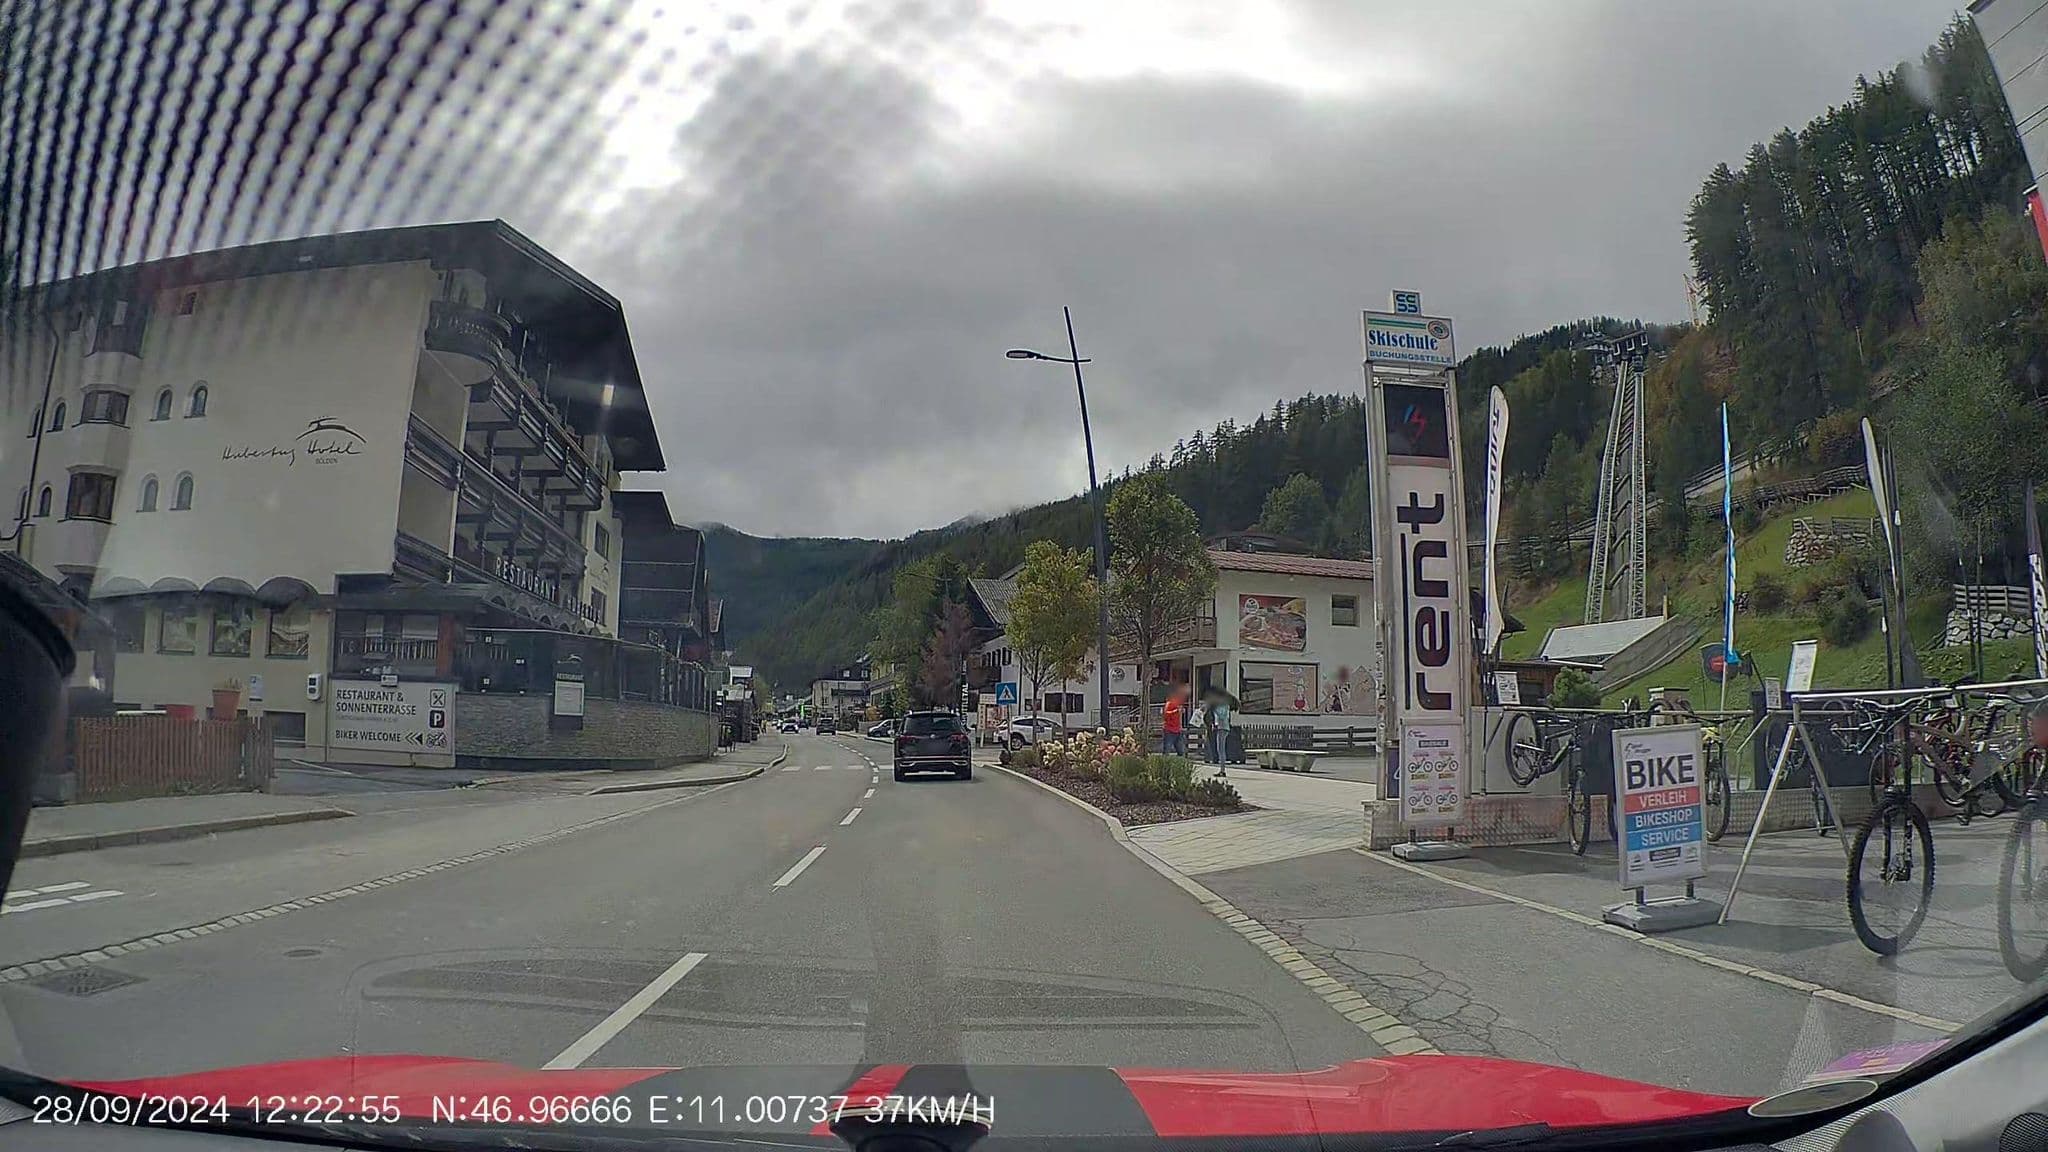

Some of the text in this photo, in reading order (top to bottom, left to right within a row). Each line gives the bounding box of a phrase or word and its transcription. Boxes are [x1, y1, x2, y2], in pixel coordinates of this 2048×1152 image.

[1368, 329, 1439, 351] Skischule
[1369, 350, 1452, 364] BUCHUNGSSTELLE
[307, 439, 363, 455] Hotel
[495, 556, 557, 602] RESTAURANT
[1397, 491, 1452, 711] rent
[336, 689, 404, 703] RESTAURANT &
[335, 702, 417, 716] SONNENTERRASSE
[335, 729, 402, 743] BIKER WELCOME
[1626, 754, 1695, 790] BIKE
[1639, 792, 1688, 808] VERLEIH
[1635, 808, 1693, 828] BIKESHOP
[1641, 827, 1689, 847] SERVICE
